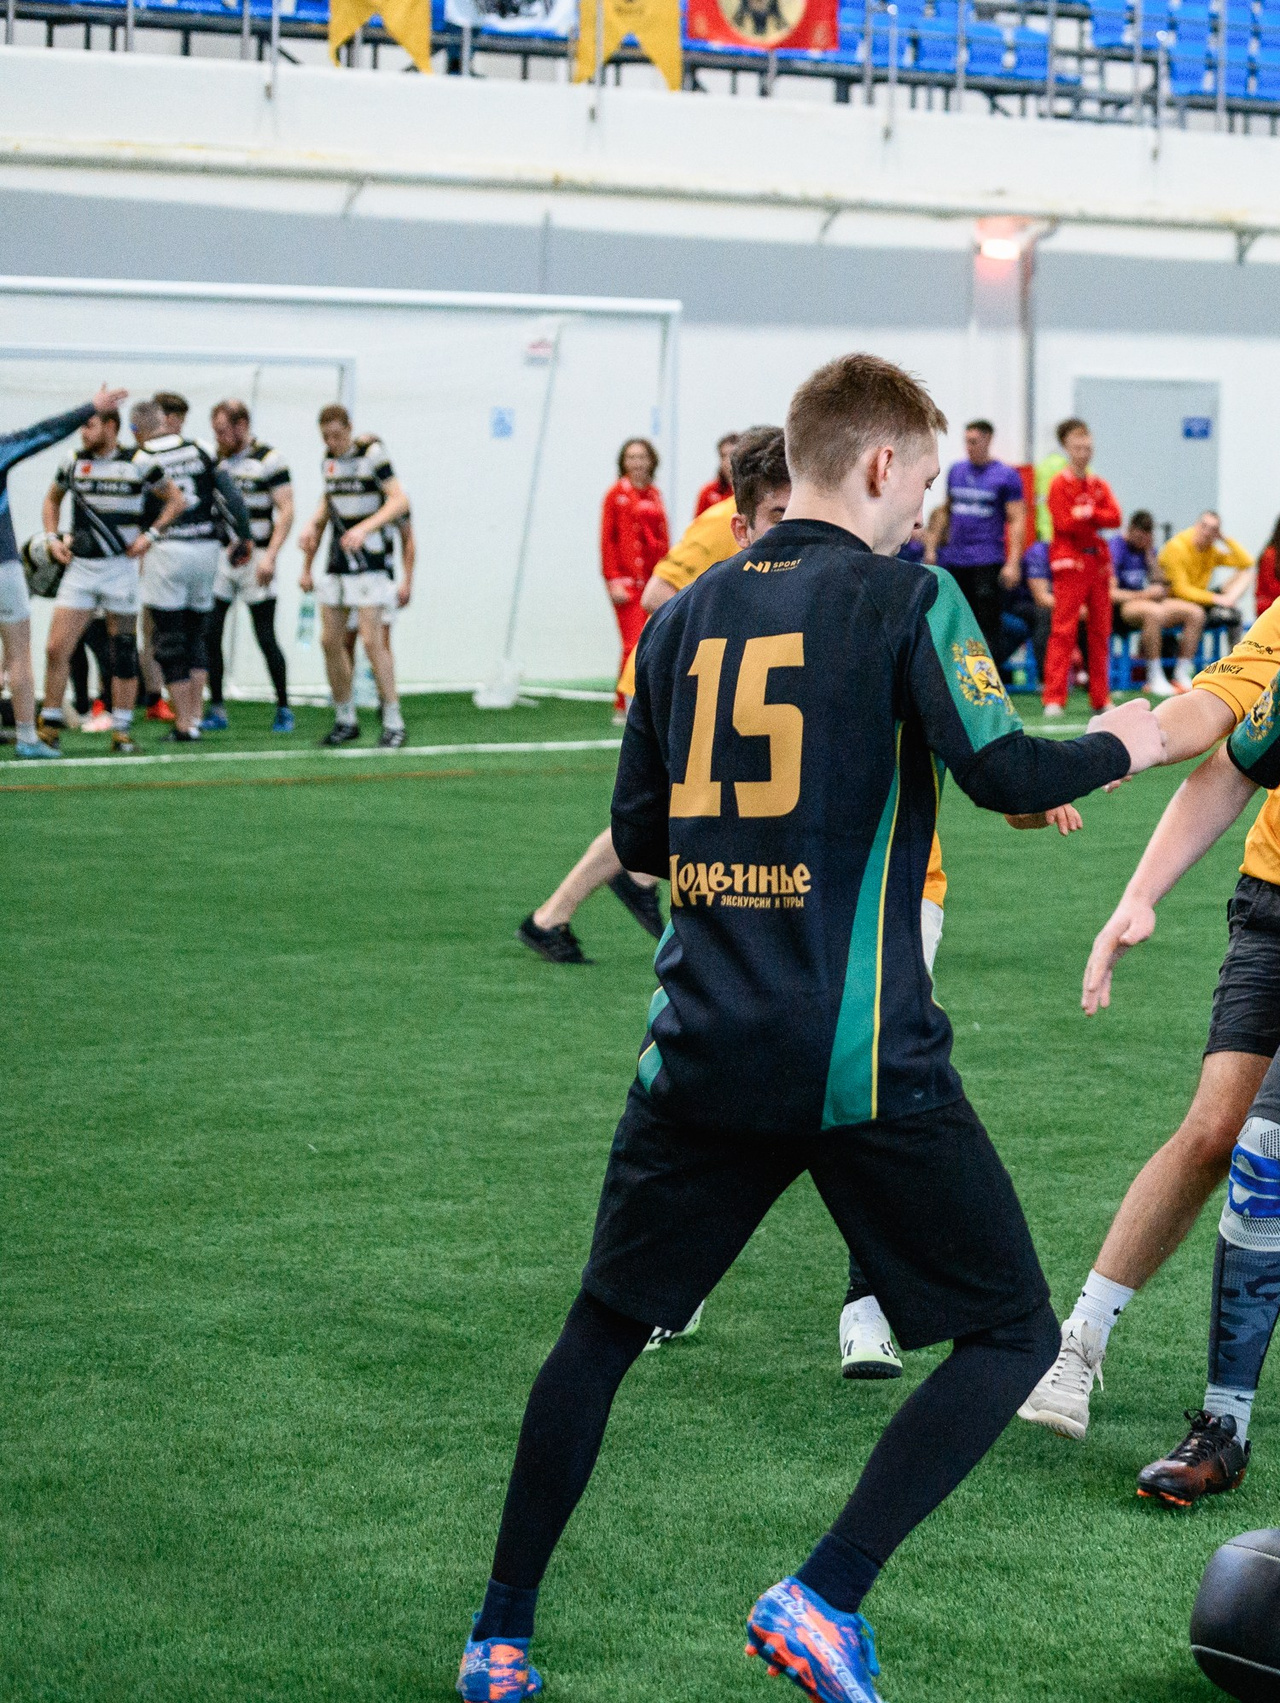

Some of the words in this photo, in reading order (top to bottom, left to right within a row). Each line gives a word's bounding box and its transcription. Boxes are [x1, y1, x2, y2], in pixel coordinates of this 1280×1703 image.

[772, 558, 801, 569] SPORT
[670, 632, 805, 818] 15
[720, 894, 771, 909] ЭКСКУРСИИ
[783, 896, 804, 908] ТУРЫ
